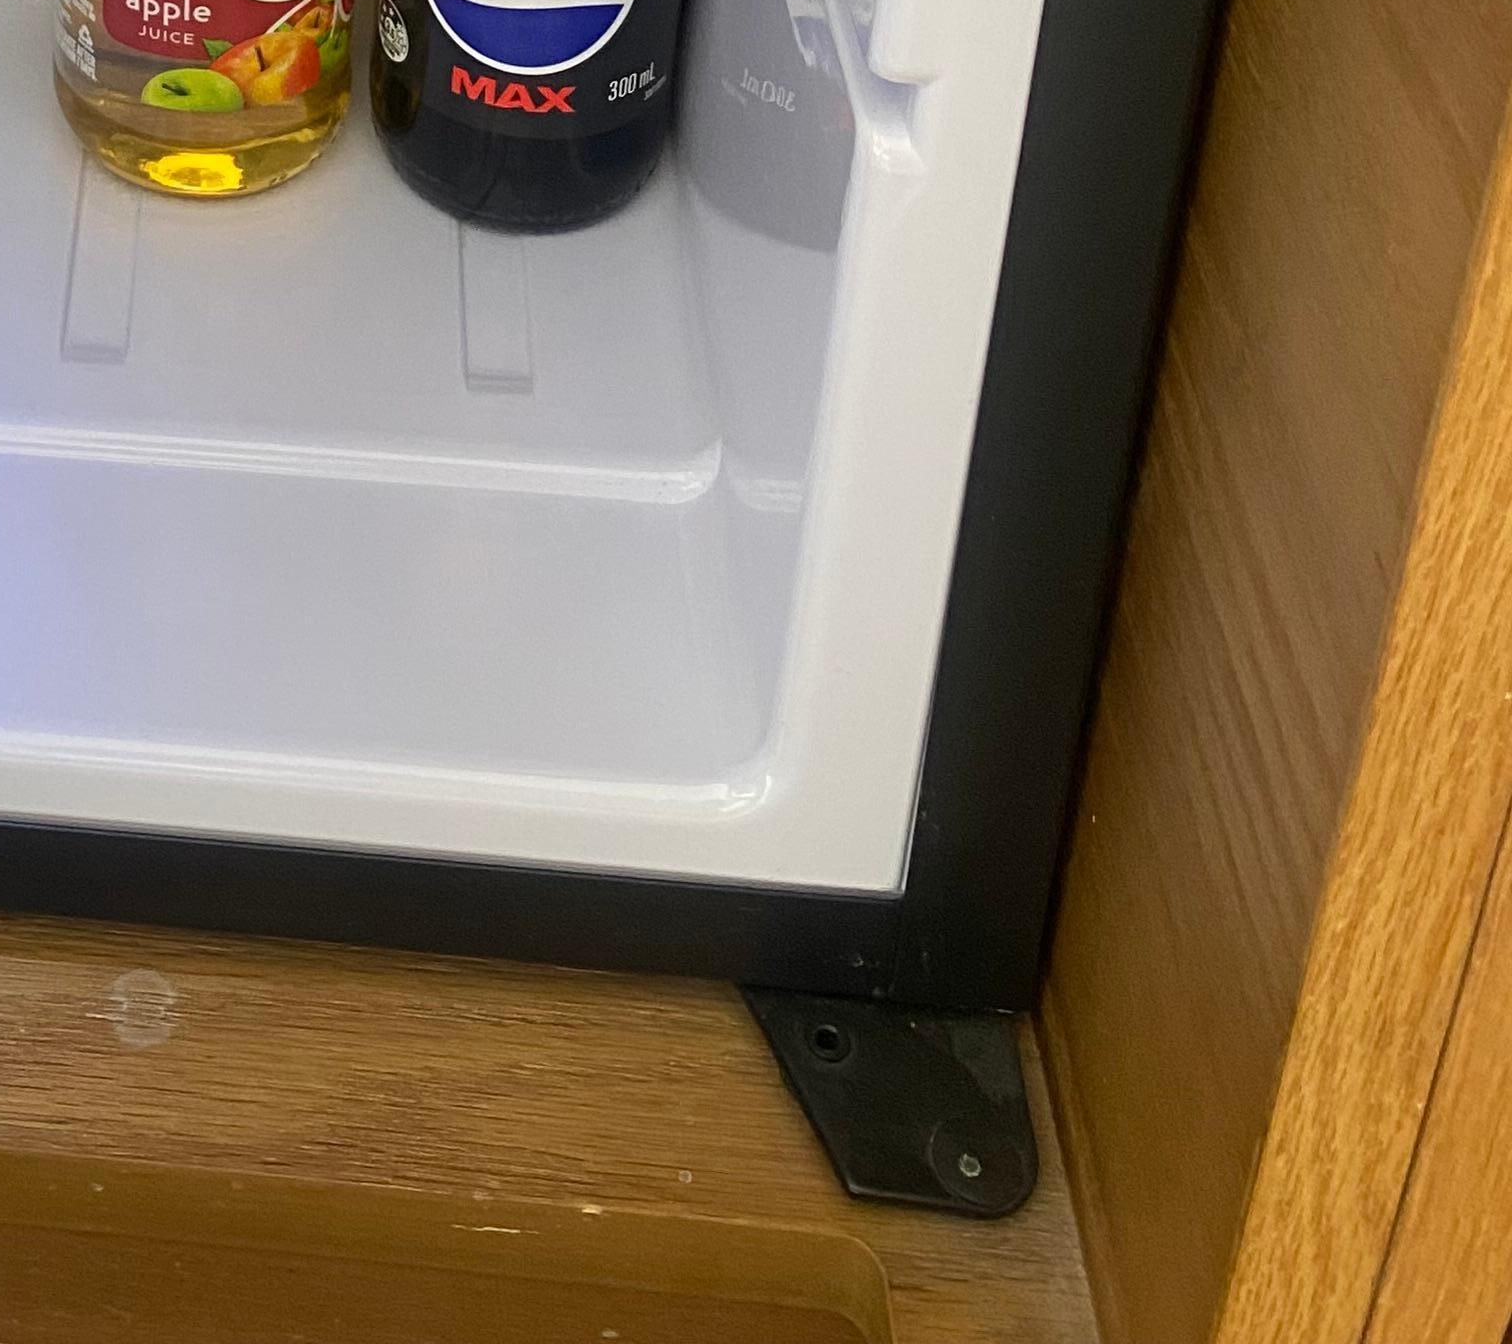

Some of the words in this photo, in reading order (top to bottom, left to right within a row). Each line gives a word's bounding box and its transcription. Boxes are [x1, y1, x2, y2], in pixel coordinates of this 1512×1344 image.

[138, 25, 195, 46] JUICE
[451, 65, 576, 114] MAX
[608, 72, 637, 101] 300
[639, 61, 656, 88] mL
